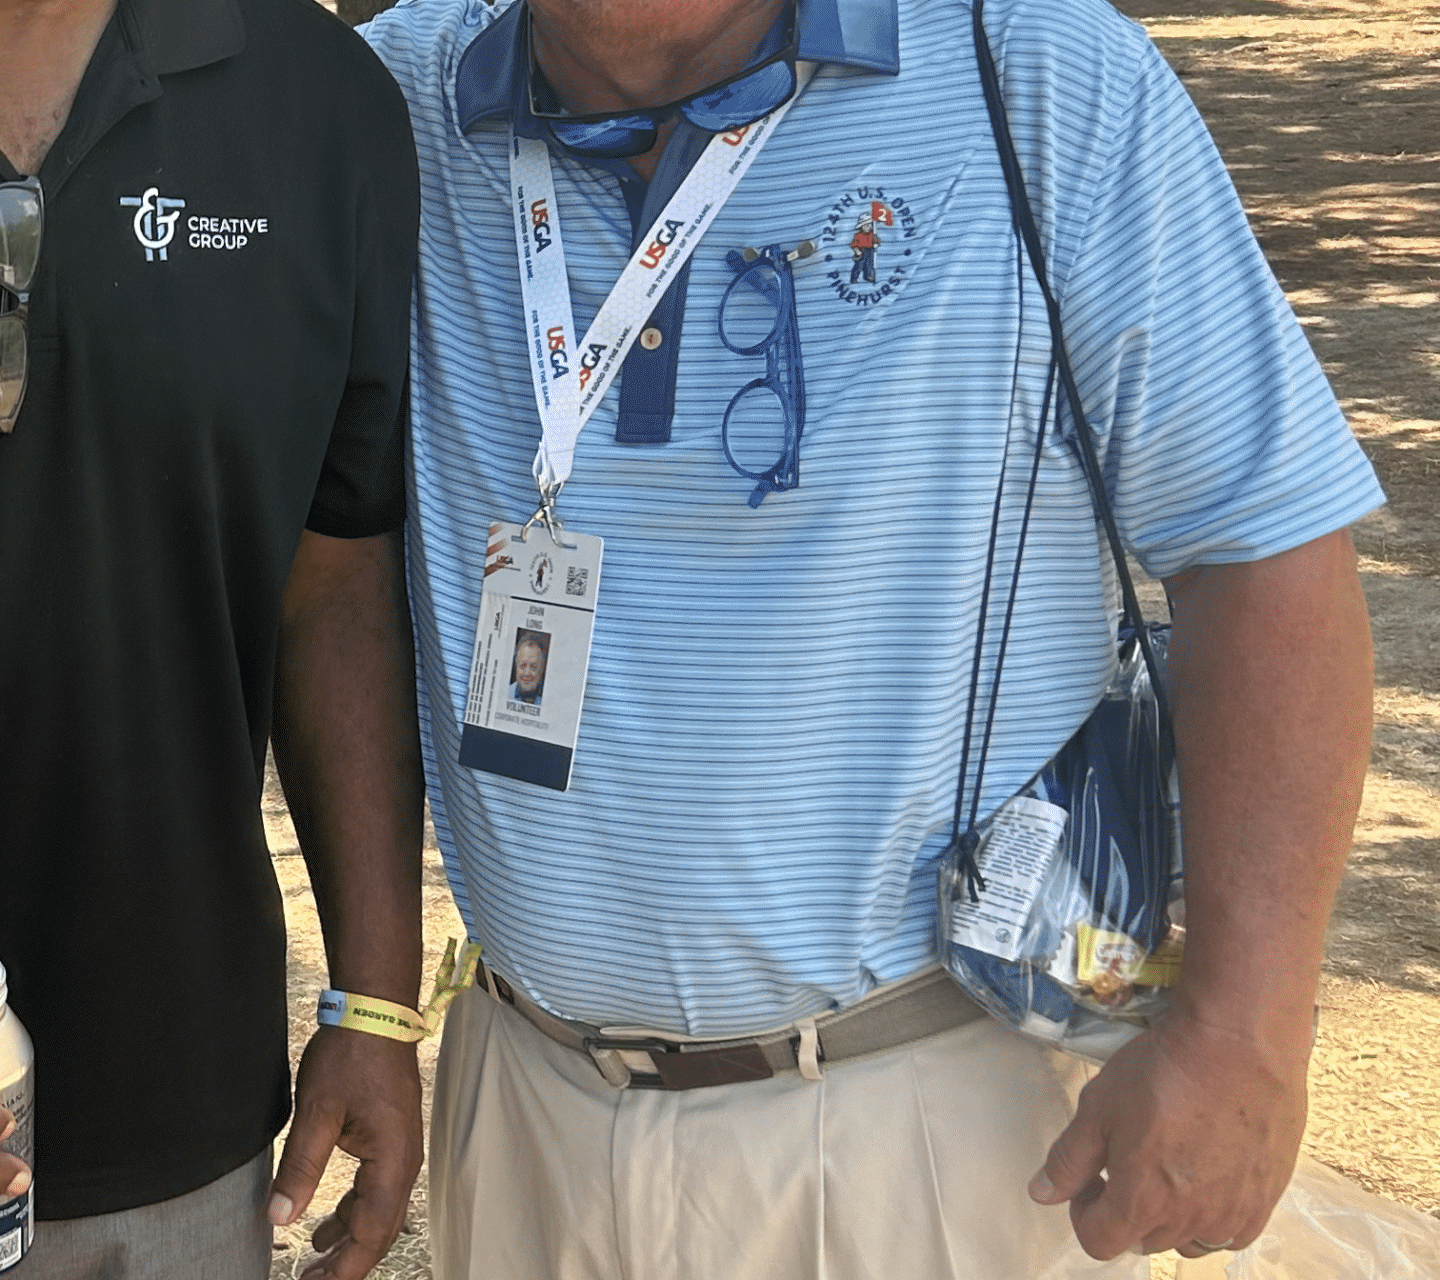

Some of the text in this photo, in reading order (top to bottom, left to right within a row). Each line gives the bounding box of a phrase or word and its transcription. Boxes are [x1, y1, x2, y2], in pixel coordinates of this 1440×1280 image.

[187, 216, 268, 233] CREATIVE
[530, 198, 552, 253] USGA
[878, 208, 888, 222] 2
[891, 197, 917, 238] OPEN
[188, 233, 248, 250] GROUP
[639, 217, 685, 270] USGA
[656, 270, 666, 283] THE
[665, 249, 681, 269] GOOD
[679, 239, 687, 248] OF
[685, 225, 696, 238] THE
[827, 265, 907, 306] PINEHURST
[546, 325, 570, 380] USGA
